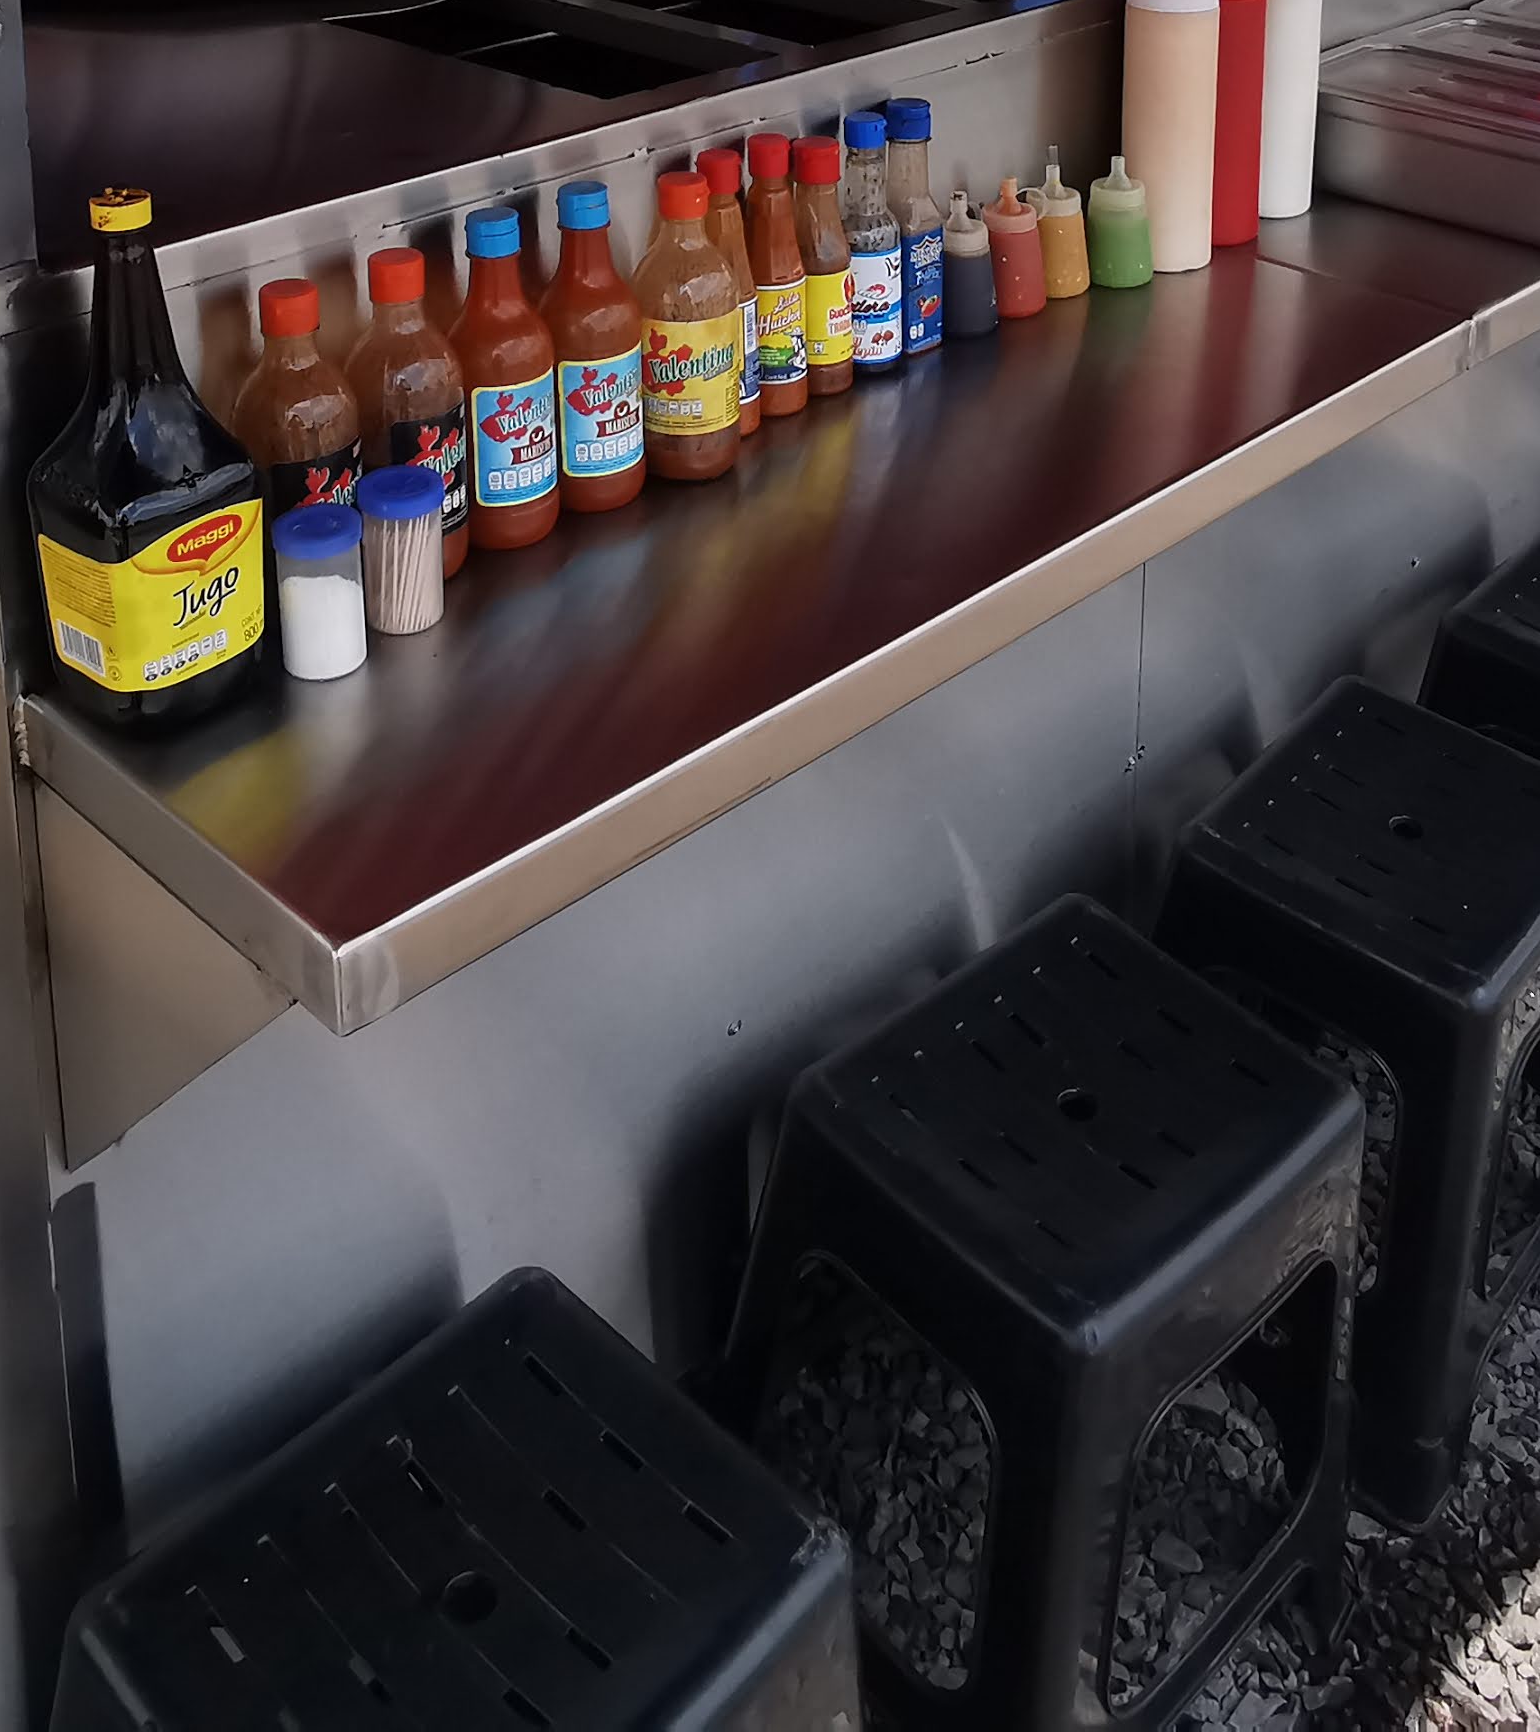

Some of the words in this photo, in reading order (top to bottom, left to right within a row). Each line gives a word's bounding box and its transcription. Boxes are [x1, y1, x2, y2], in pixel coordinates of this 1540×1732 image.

[650, 342, 735, 384] Valentina
[177, 520, 234, 557] Maggi
[173, 567, 239, 627] Jugo
